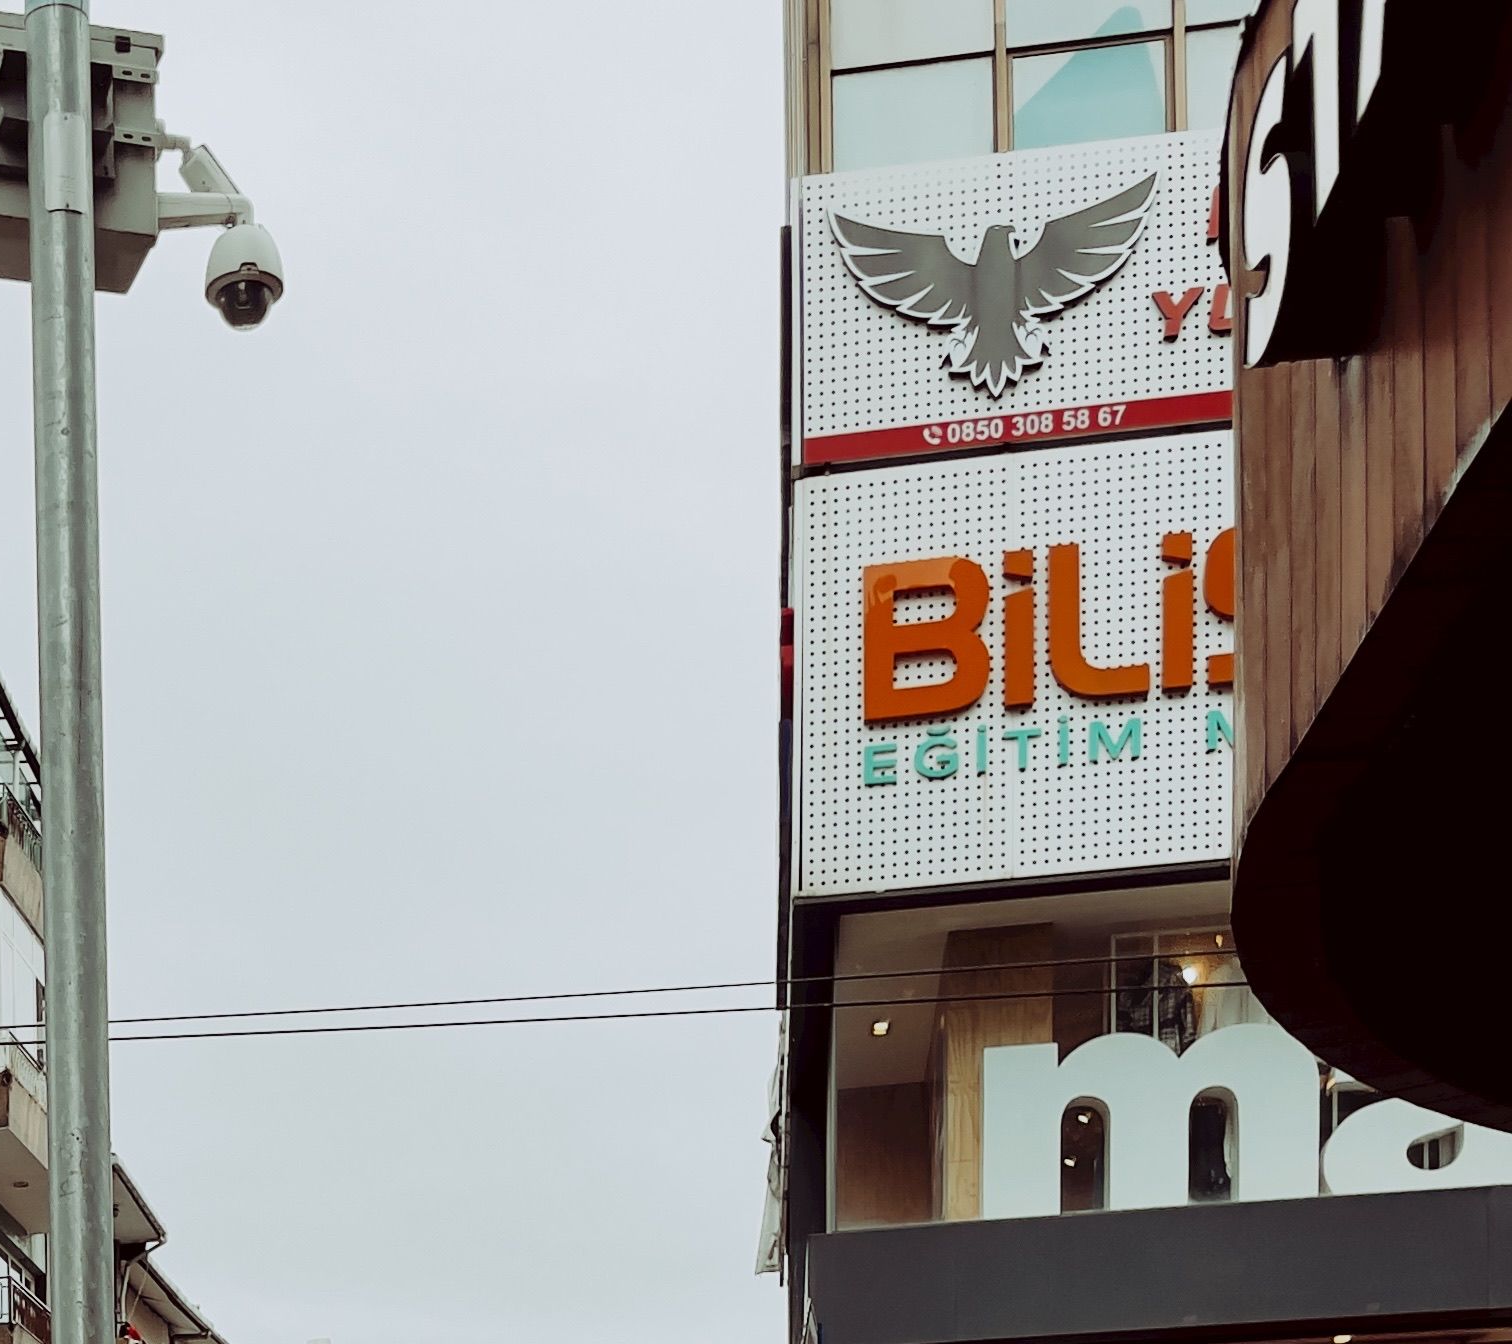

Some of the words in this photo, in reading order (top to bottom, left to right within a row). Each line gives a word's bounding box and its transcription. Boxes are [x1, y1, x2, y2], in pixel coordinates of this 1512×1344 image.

[946, 418, 1004, 444] 0850
[1011, 412, 1054, 438] 308
[1062, 408, 1090, 431] 58
[1097, 404, 1127, 428] 67
